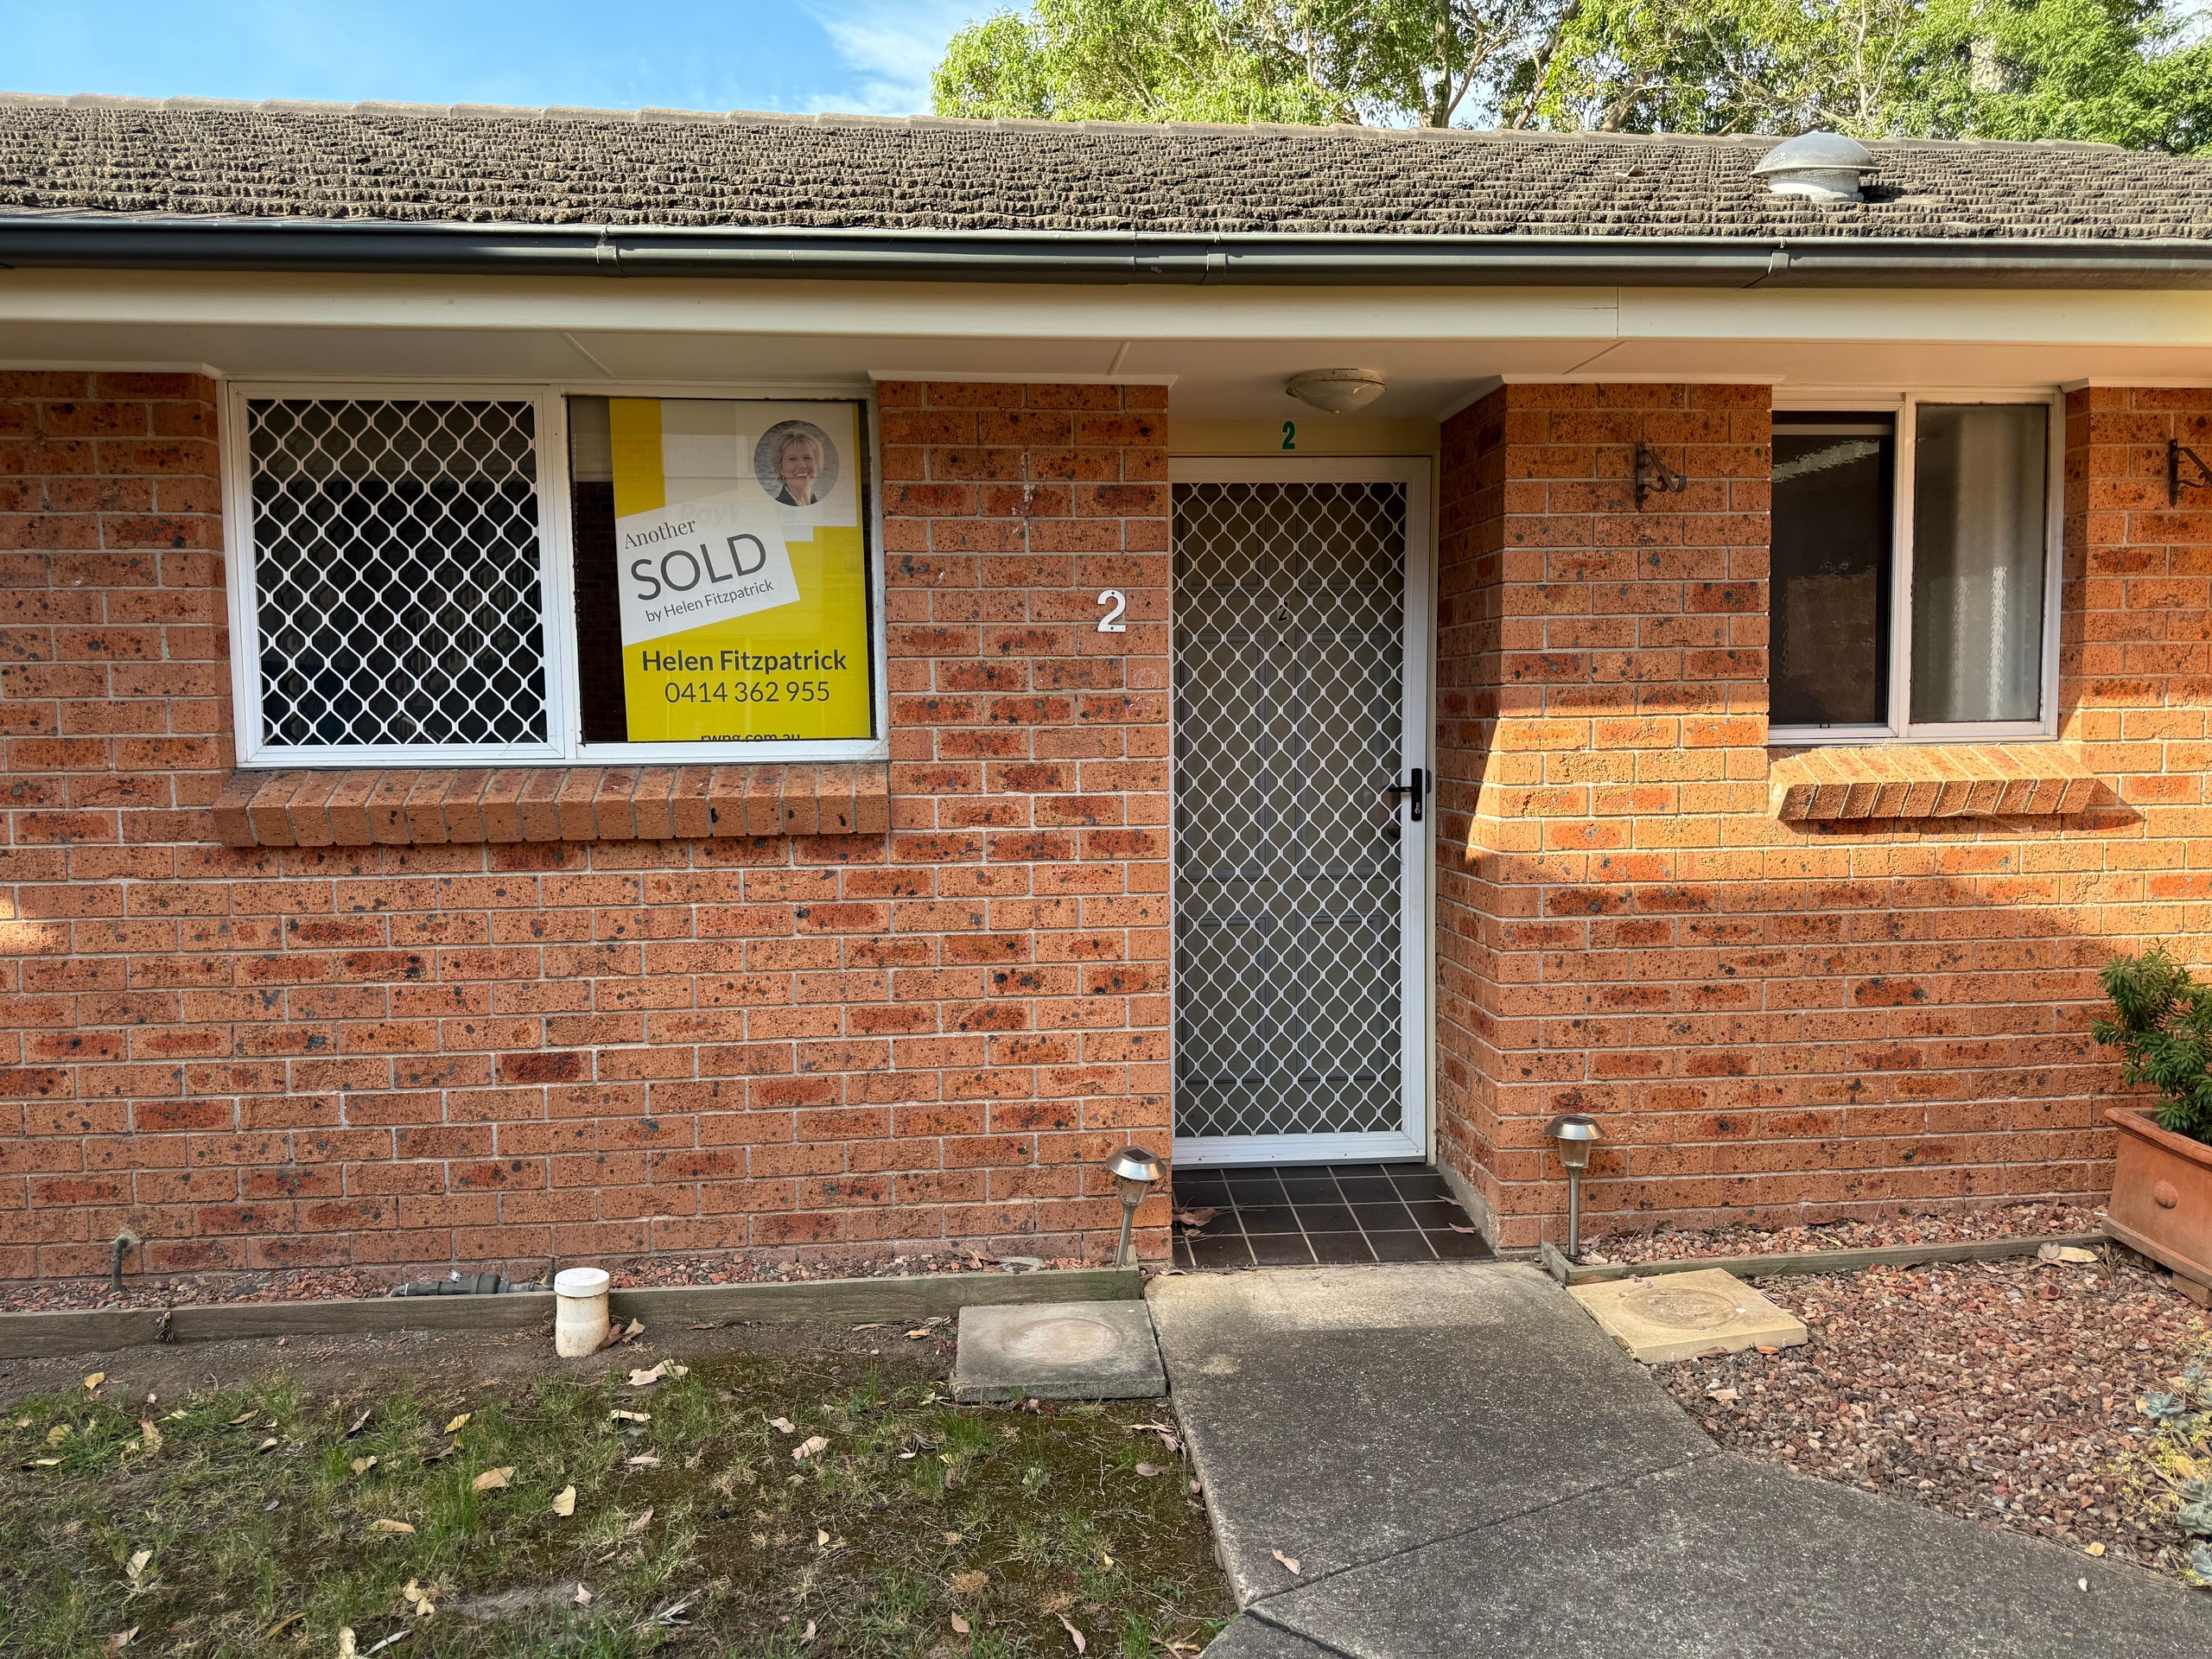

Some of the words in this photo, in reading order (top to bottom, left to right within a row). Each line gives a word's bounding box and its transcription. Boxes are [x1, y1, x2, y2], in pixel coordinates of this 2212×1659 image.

[1282, 421, 1295, 449] 2
[625, 520, 696, 549] Another
[631, 533, 766, 601] SOLD
[645, 610, 662, 622] by
[664, 601, 703, 618] Helen
[704, 579, 774, 607] Fitzpatrick
[1097, 589, 1126, 632] 2
[1279, 601, 1287, 621] 2
[642, 650, 714, 671] Helen
[720, 650, 847, 675] Fitzpatrick
[664, 682, 728, 702] 0414
[734, 681, 779, 702] 362
[786, 681, 830, 702] 955
